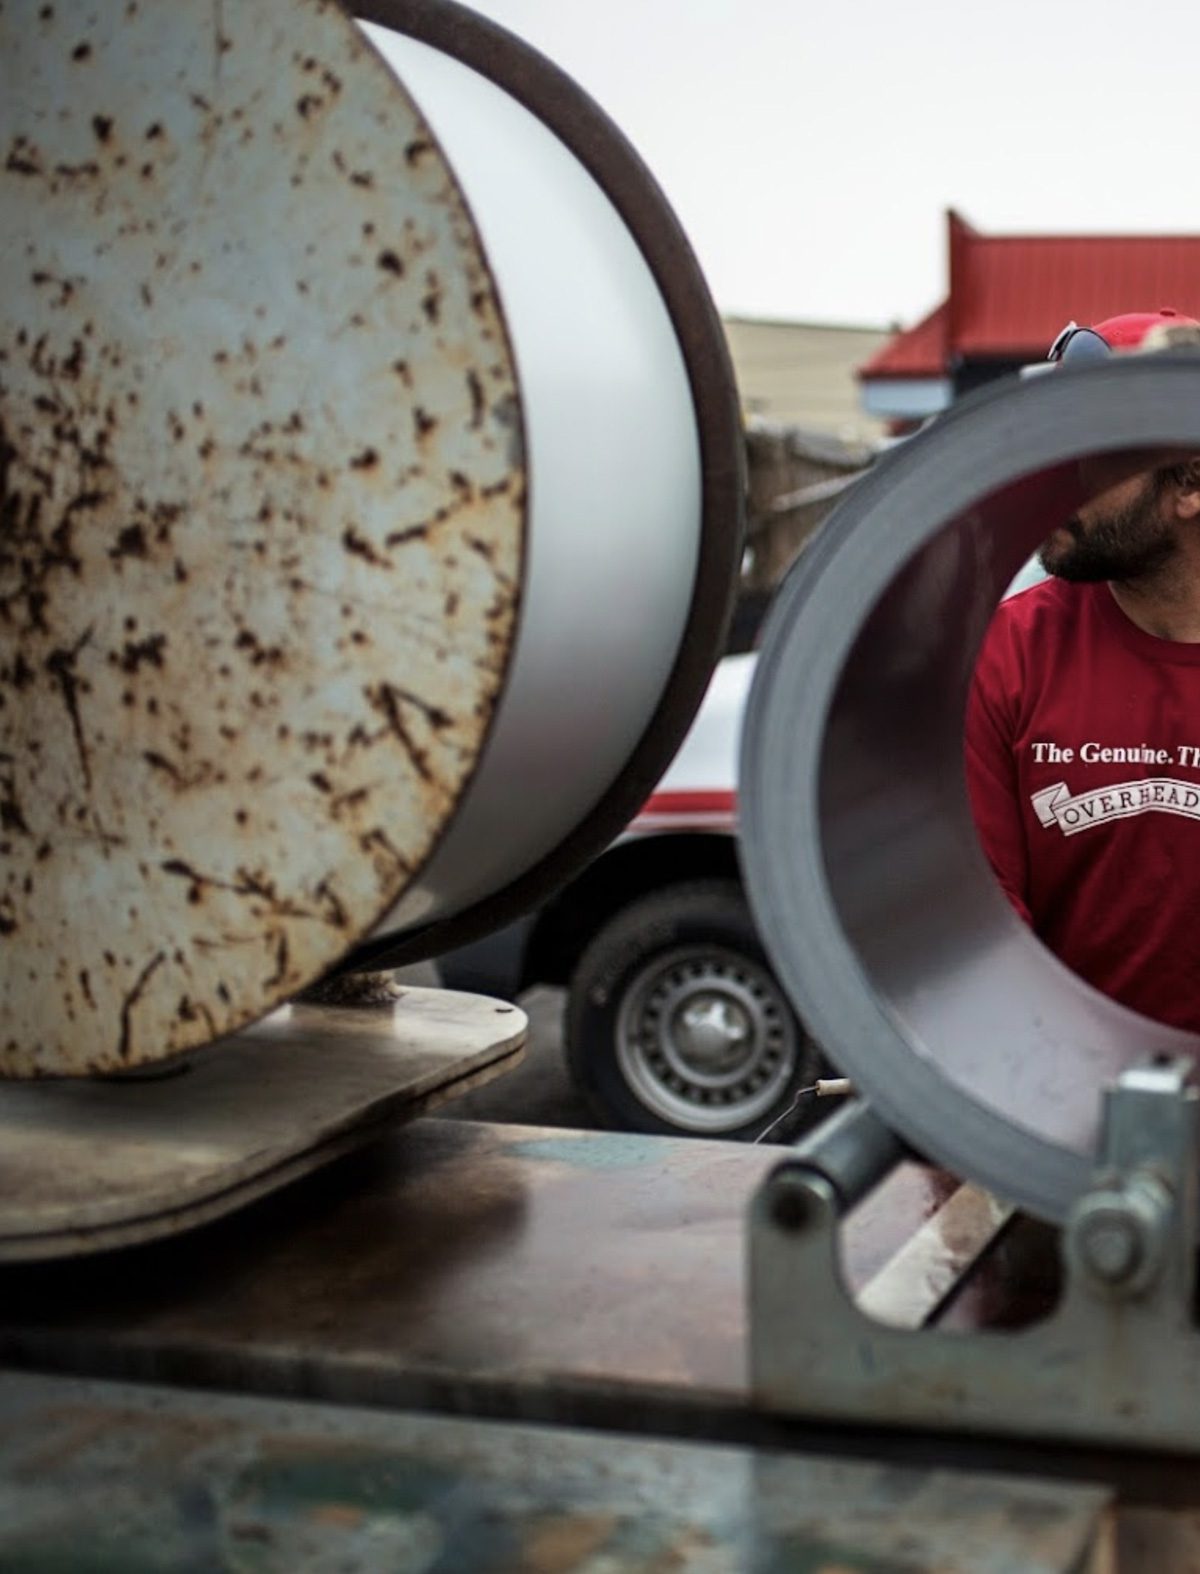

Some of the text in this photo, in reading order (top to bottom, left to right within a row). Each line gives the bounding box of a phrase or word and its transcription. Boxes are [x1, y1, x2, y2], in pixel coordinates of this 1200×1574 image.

[1031, 743, 1075, 763] The
[1080, 742, 1174, 764] Genuine.
[1063, 785, 1200, 825] OVERHEAD
